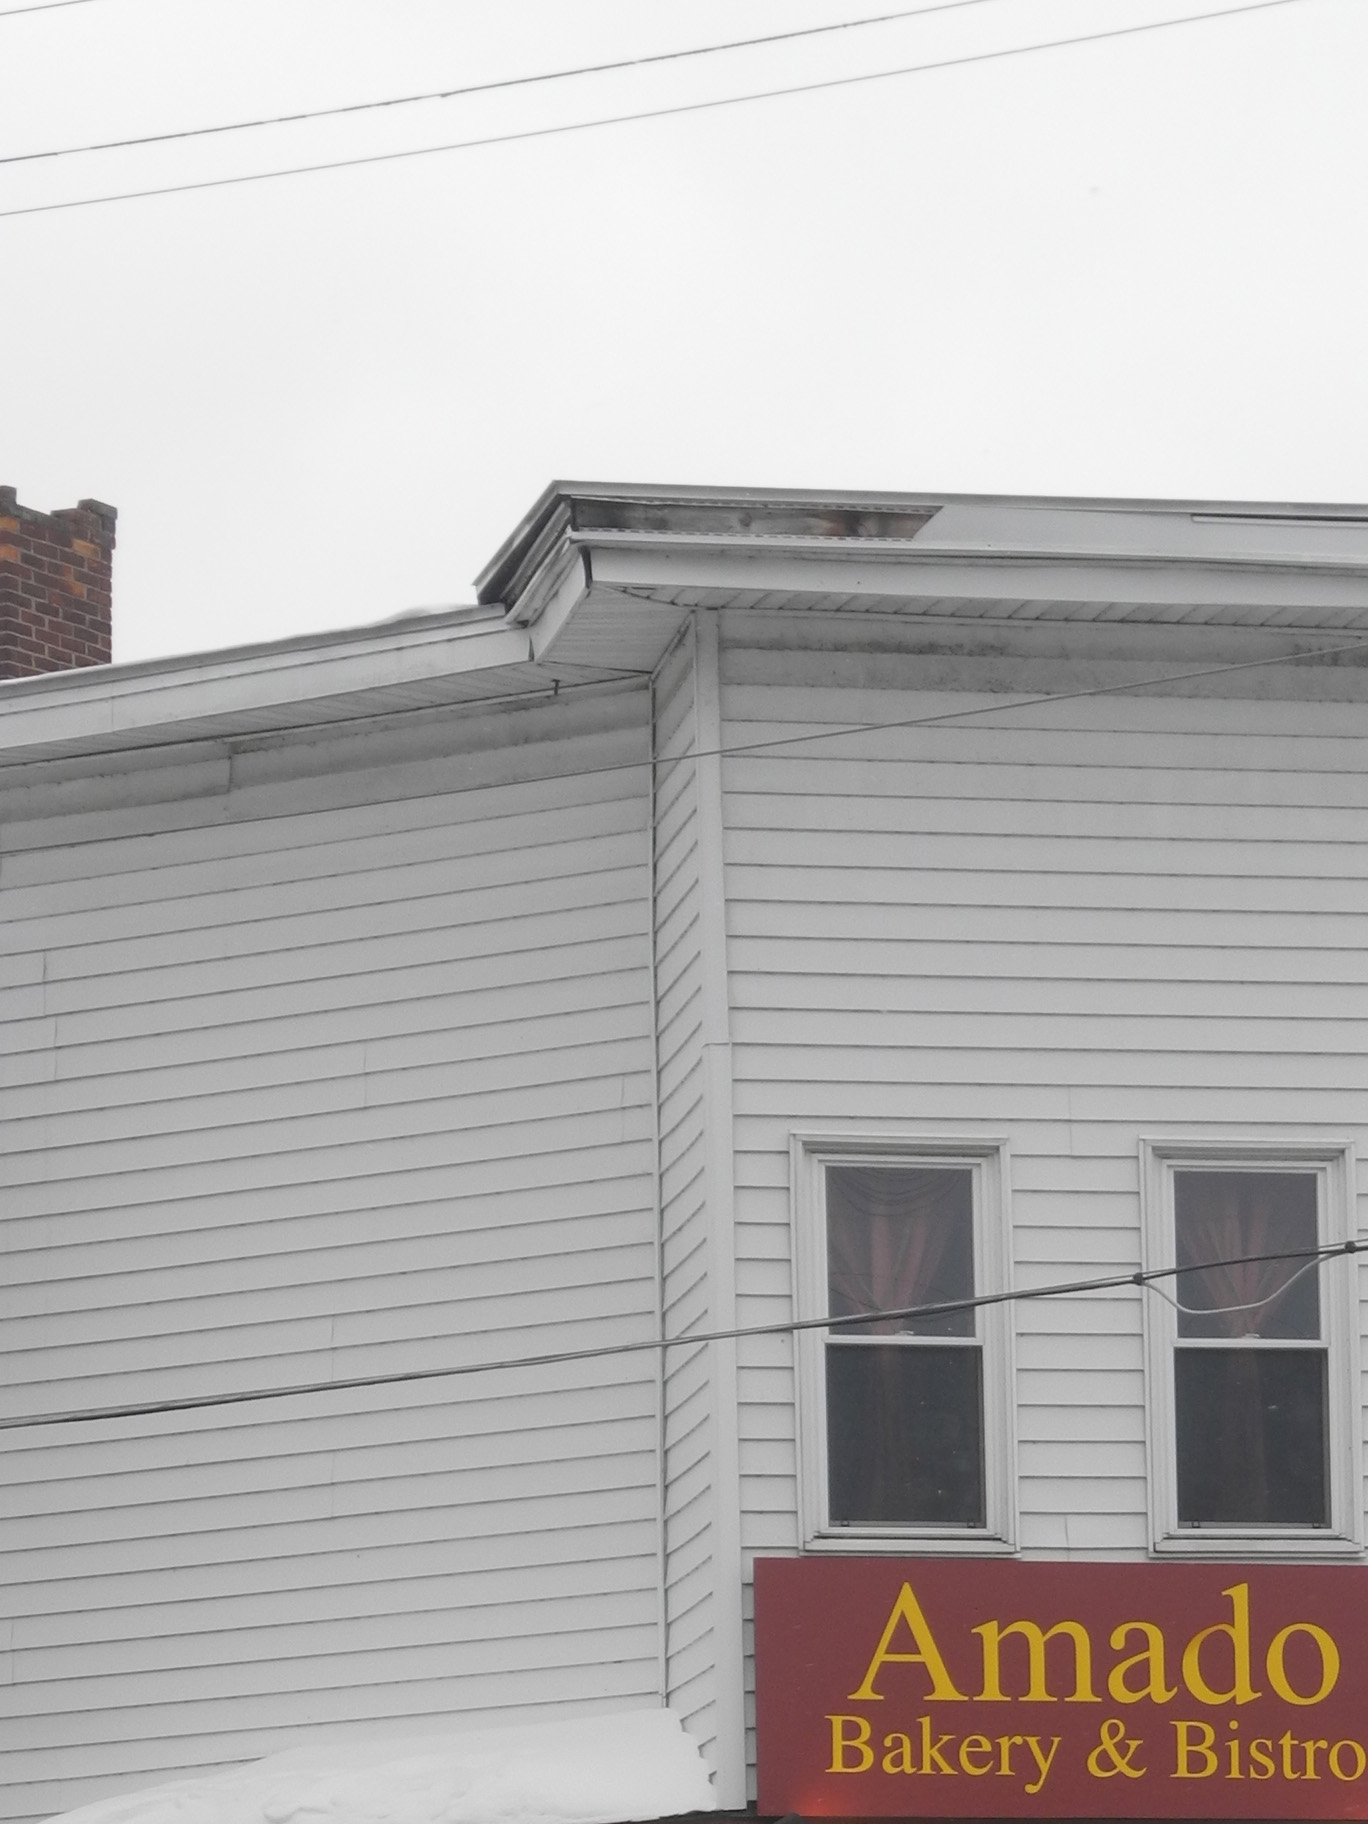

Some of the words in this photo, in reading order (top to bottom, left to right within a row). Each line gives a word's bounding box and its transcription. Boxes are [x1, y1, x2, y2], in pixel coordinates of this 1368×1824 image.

[848, 1581, 1341, 1706] Amado
[825, 1714, 1062, 1795] Bakery
[1086, 1718, 1147, 1779] &
[1170, 1719, 1368, 1781] Bistro
